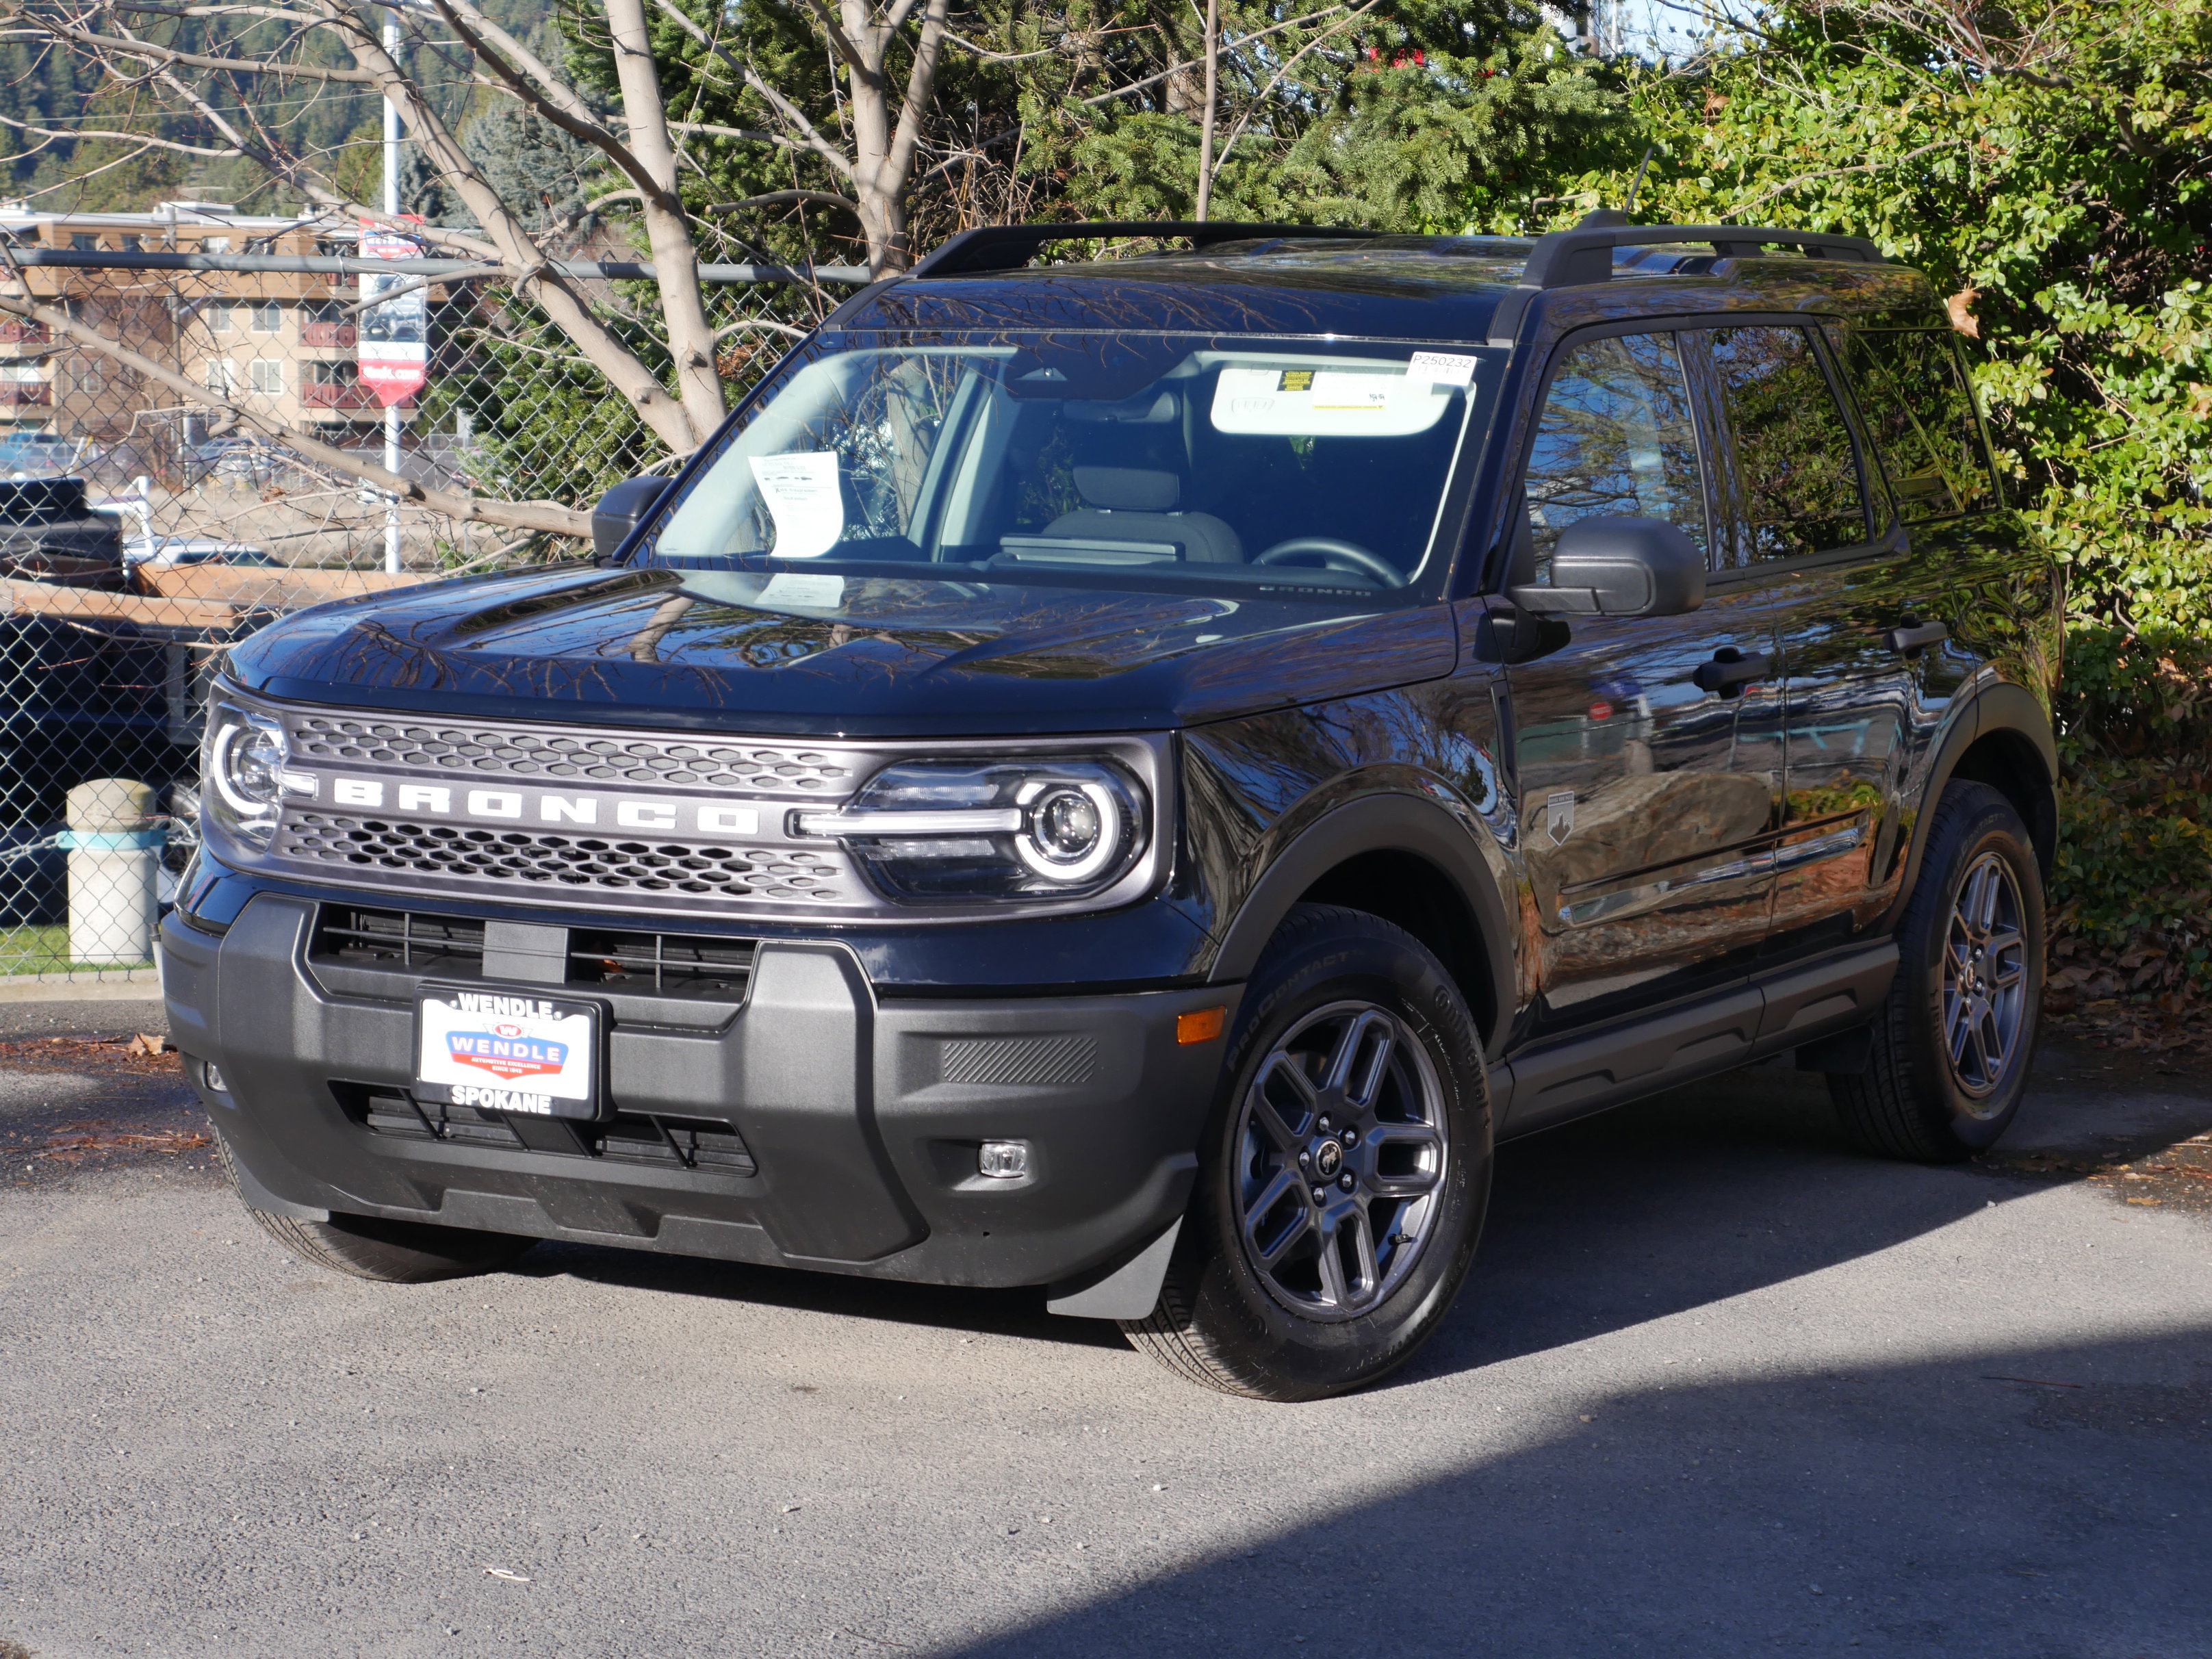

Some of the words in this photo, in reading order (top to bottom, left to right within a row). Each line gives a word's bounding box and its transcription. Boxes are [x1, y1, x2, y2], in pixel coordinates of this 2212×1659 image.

[1413, 355, 1472, 369] P250232
[333, 777, 760, 835] BRONCO
[457, 992, 554, 1020] WENDLE
[499, 1025, 518, 1036] W
[451, 1036, 560, 1062] WENDLE
[471, 1056, 507, 1066] AUTOMOTIVE
[507, 1060, 541, 1070] EXCELLENCE
[451, 1085, 552, 1115] SPOKANE
